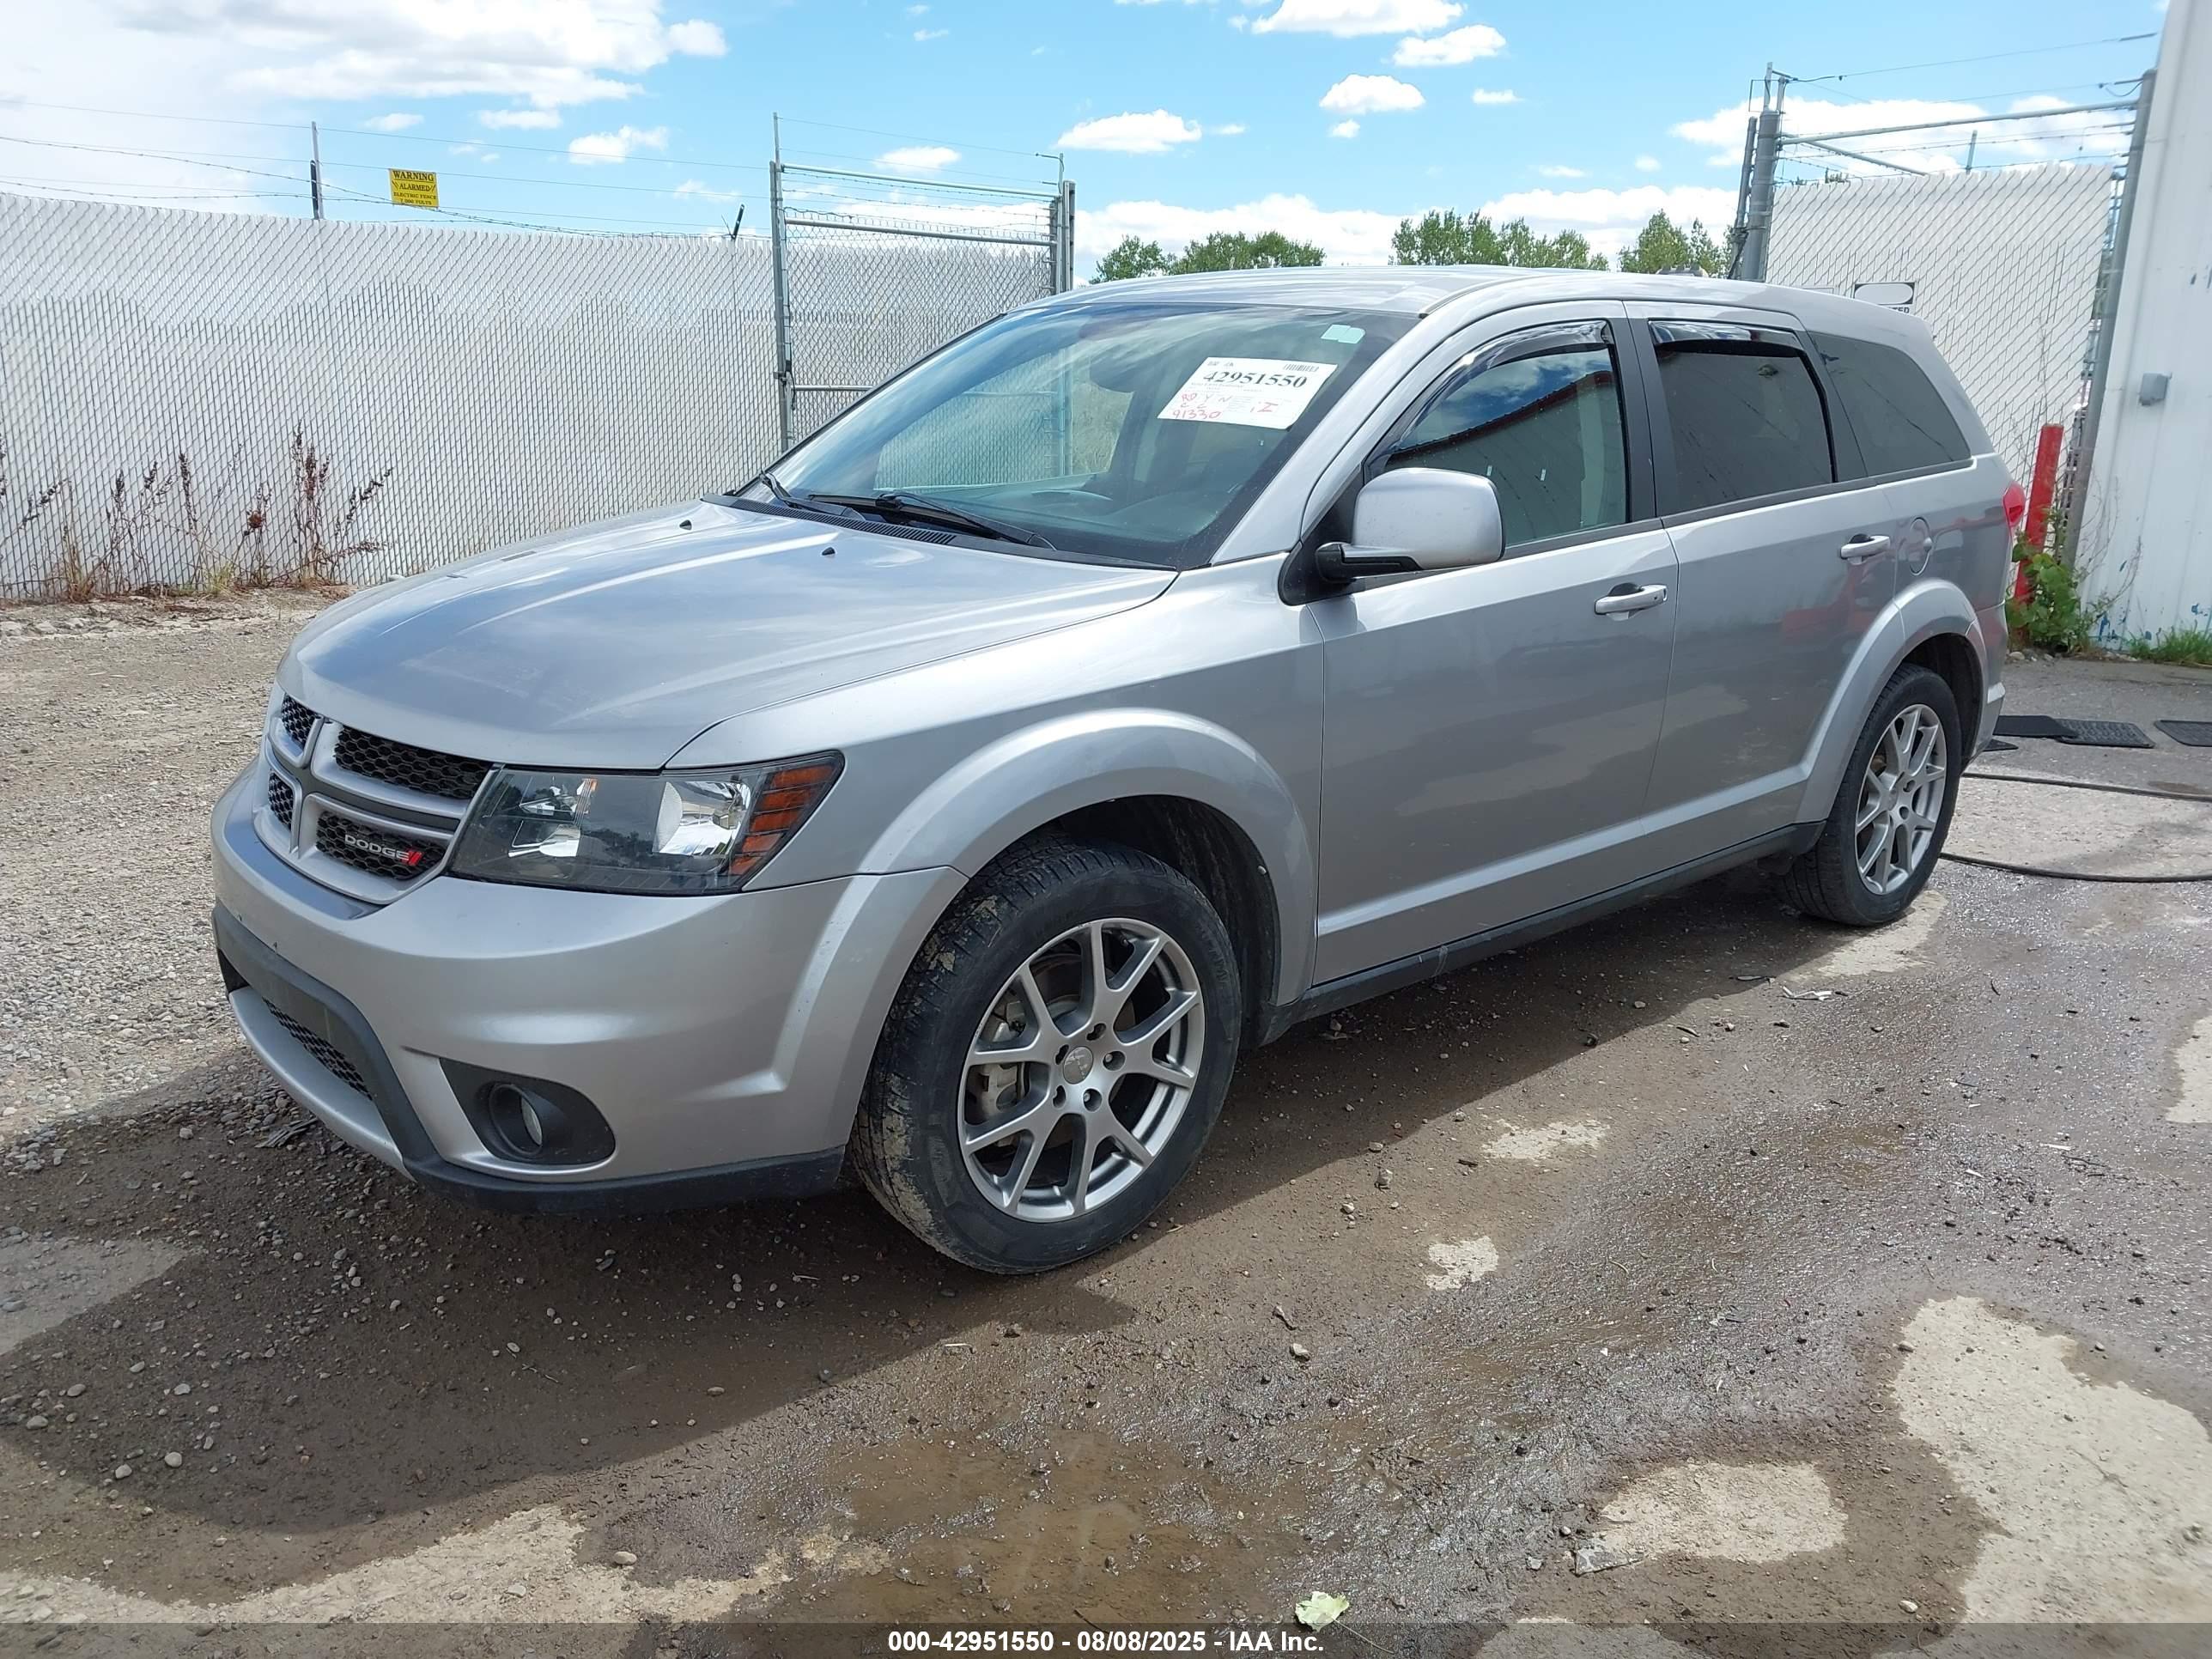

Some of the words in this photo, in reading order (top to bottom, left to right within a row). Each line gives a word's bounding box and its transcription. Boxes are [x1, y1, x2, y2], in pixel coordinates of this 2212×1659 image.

[392, 171, 434, 181] WARNING
[399, 183, 430, 191] ALARMED
[1203, 371, 1307, 388] 42951550
[345, 835, 410, 860] DODGE
